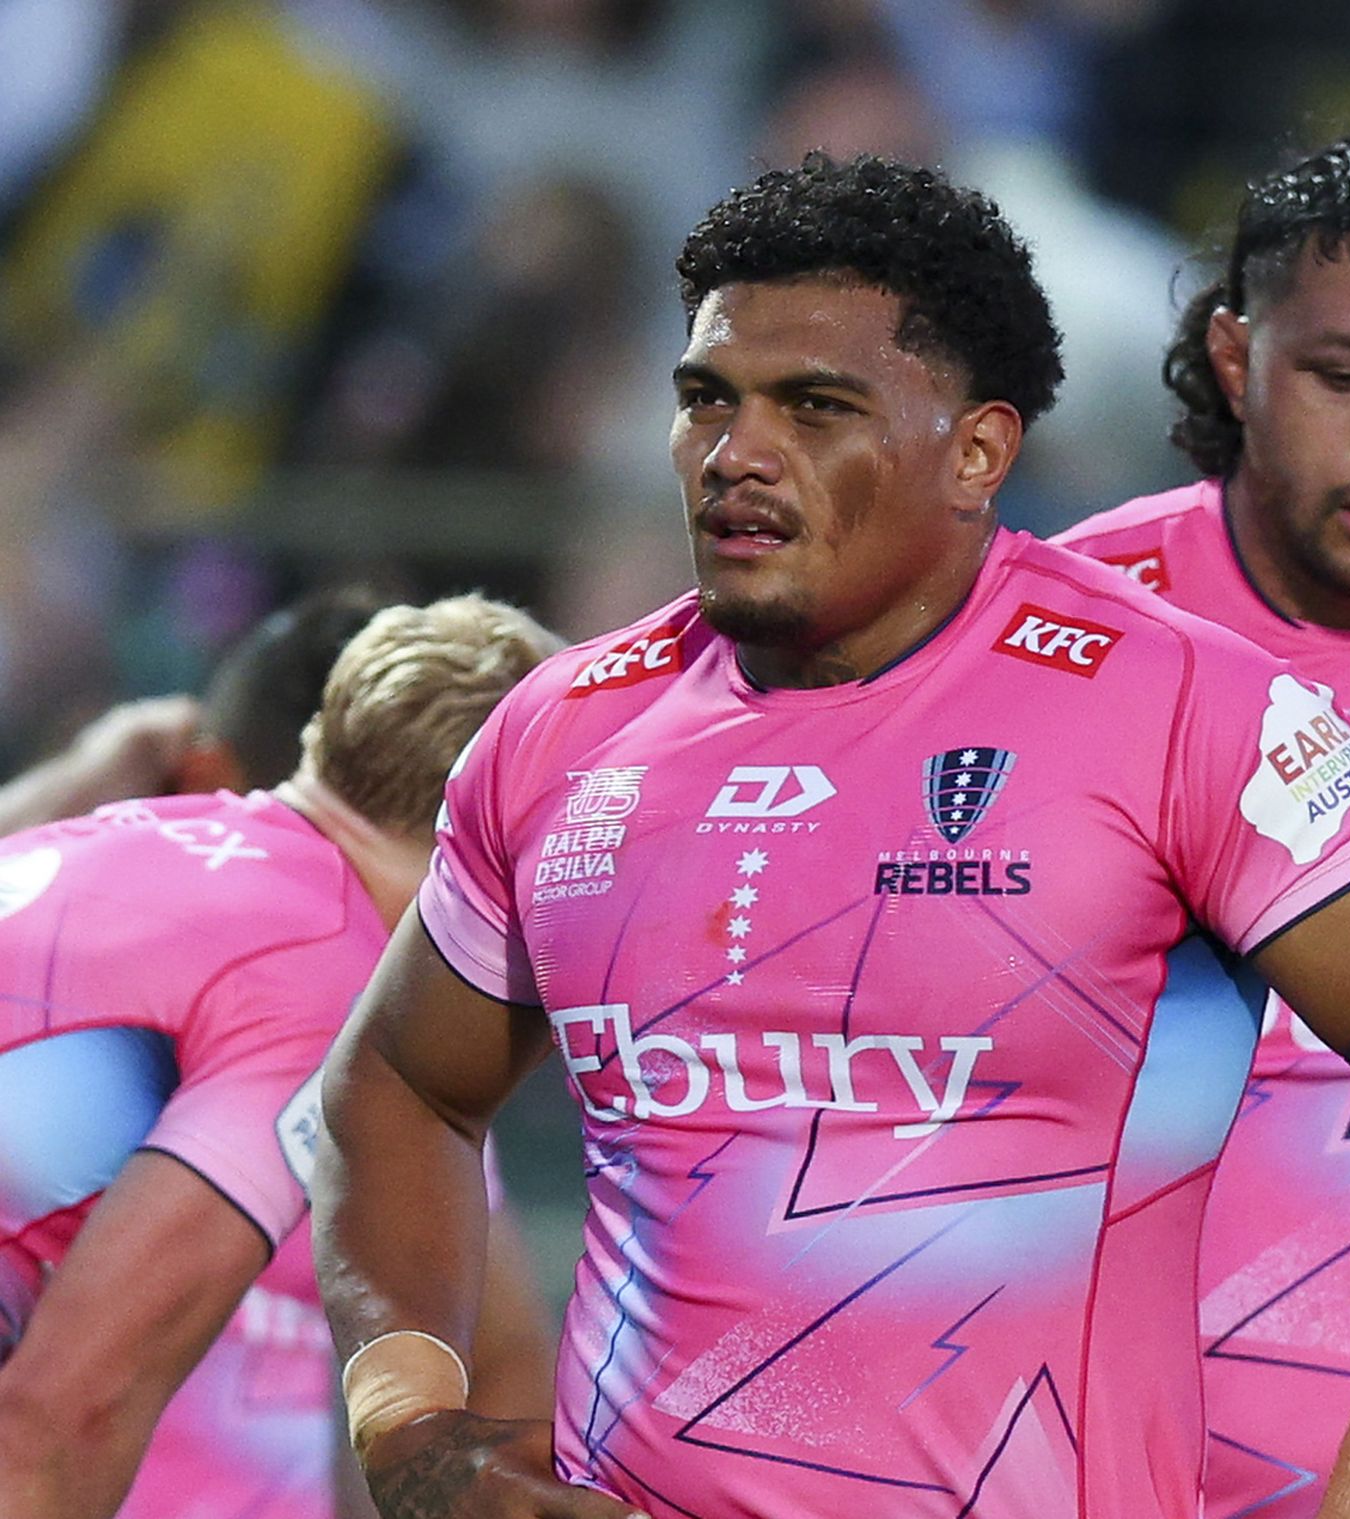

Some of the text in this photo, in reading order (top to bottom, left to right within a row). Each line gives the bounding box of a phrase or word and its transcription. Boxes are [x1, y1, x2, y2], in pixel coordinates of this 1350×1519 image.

[1004, 615, 1113, 666] KFC
[571, 637, 678, 688] KFC
[541, 824, 628, 858] RALPH
[695, 822, 822, 834] DYNASTY
[534, 851, 616, 887] D'SILVA
[877, 848, 1031, 862] MELBOURNE
[874, 860, 1032, 896] REBELS
[549, 1002, 994, 1140] Ebury
